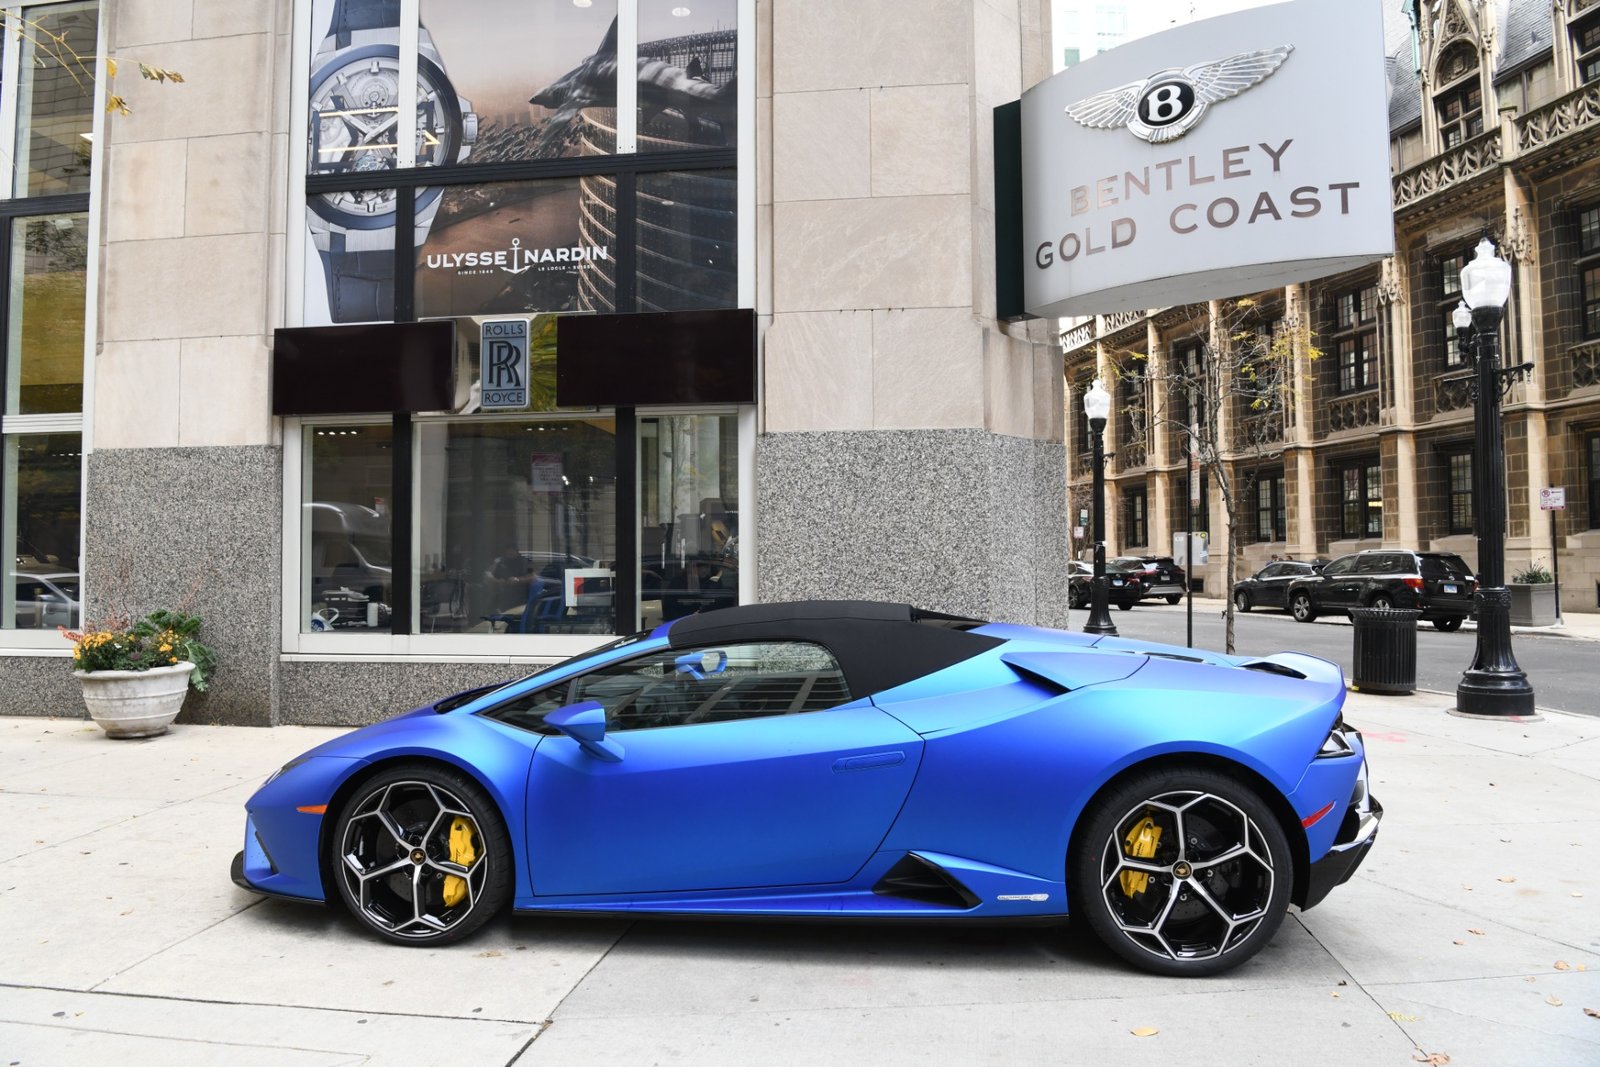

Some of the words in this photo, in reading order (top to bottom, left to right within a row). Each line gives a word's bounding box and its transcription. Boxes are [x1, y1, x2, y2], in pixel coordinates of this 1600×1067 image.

[1147, 84, 1183, 122] B
[1070, 139, 1294, 217] BENTLEY
[1035, 217, 1137, 270] GOLD
[1169, 182, 1360, 235] COAST
[427, 251, 507, 269] ULYSSE
[524, 246, 608, 264] NARDIN
[485, 324, 523, 336] ROLLS
[484, 392, 523, 403] ROYCE
